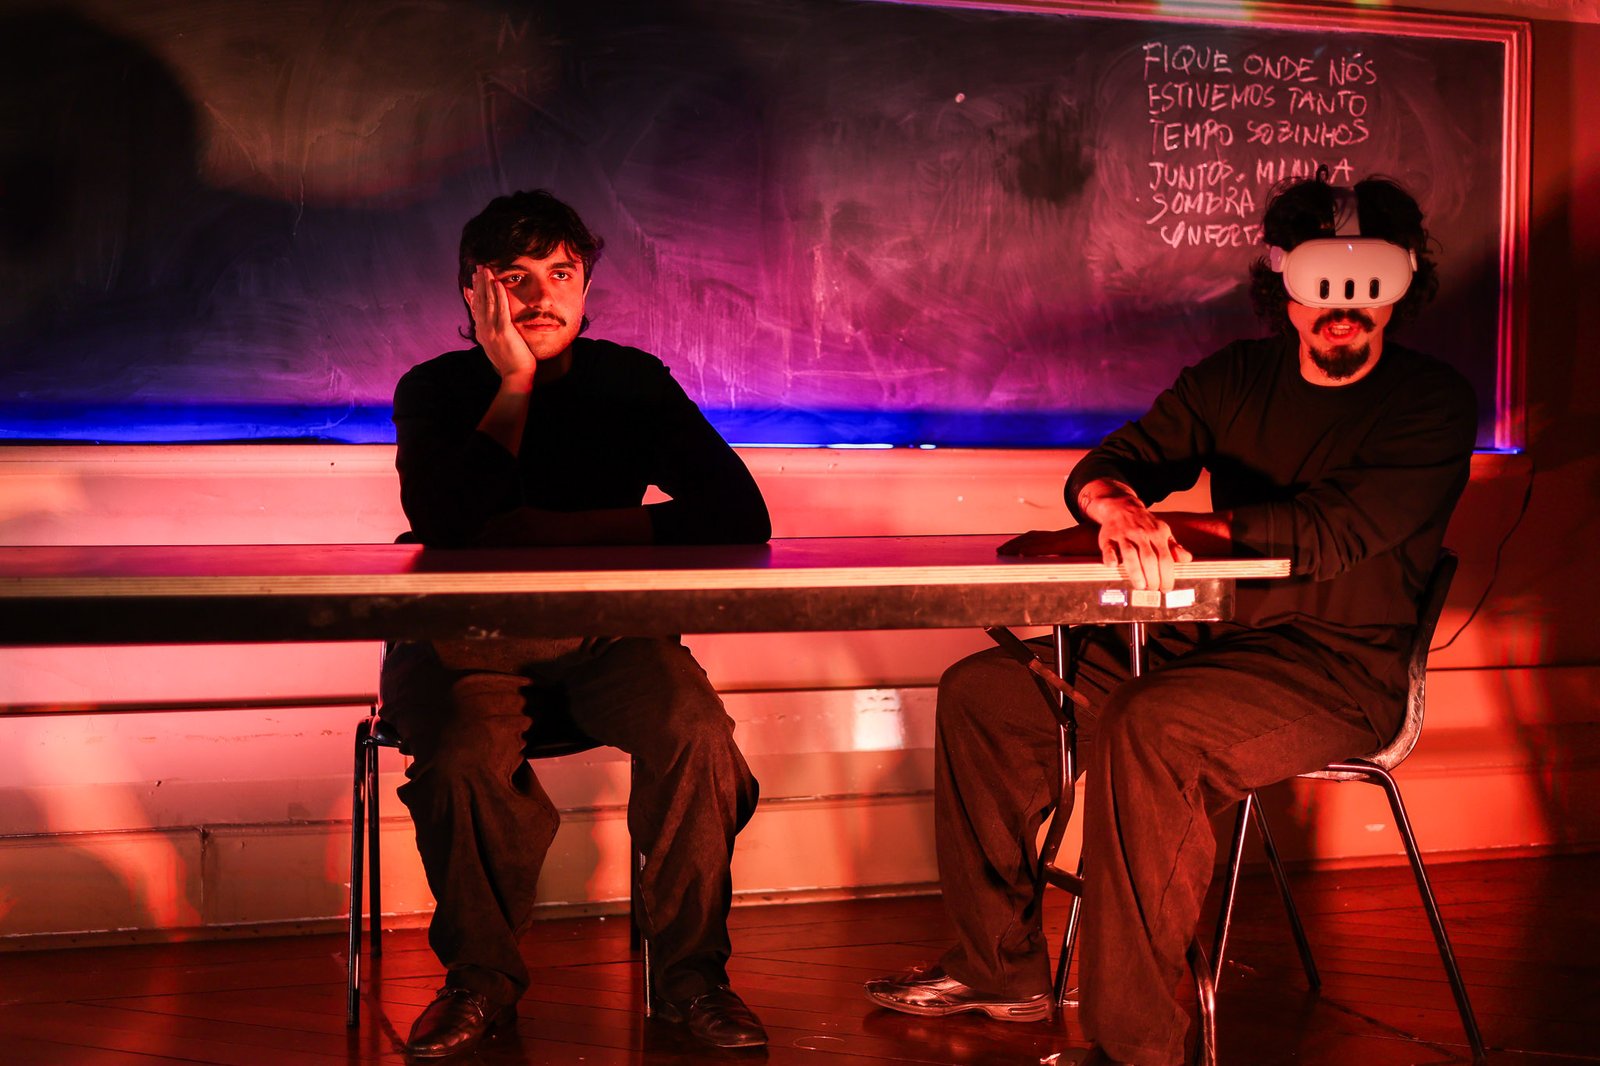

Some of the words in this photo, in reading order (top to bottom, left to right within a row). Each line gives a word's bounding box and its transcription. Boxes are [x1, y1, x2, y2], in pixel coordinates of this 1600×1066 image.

[1143, 42, 1232, 80] FIQUE
[1243, 54, 1319, 82] ONDE
[1329, 52, 1377, 86] NÓS
[1148, 81, 1276, 115] ESTIVEMOS
[1288, 87, 1368, 117] TANTO
[1149, 118, 1234, 155] TEMPO
[1246, 119, 1370, 148] SOZINHOS
[1146, 186, 1256, 224] SOMBRA
